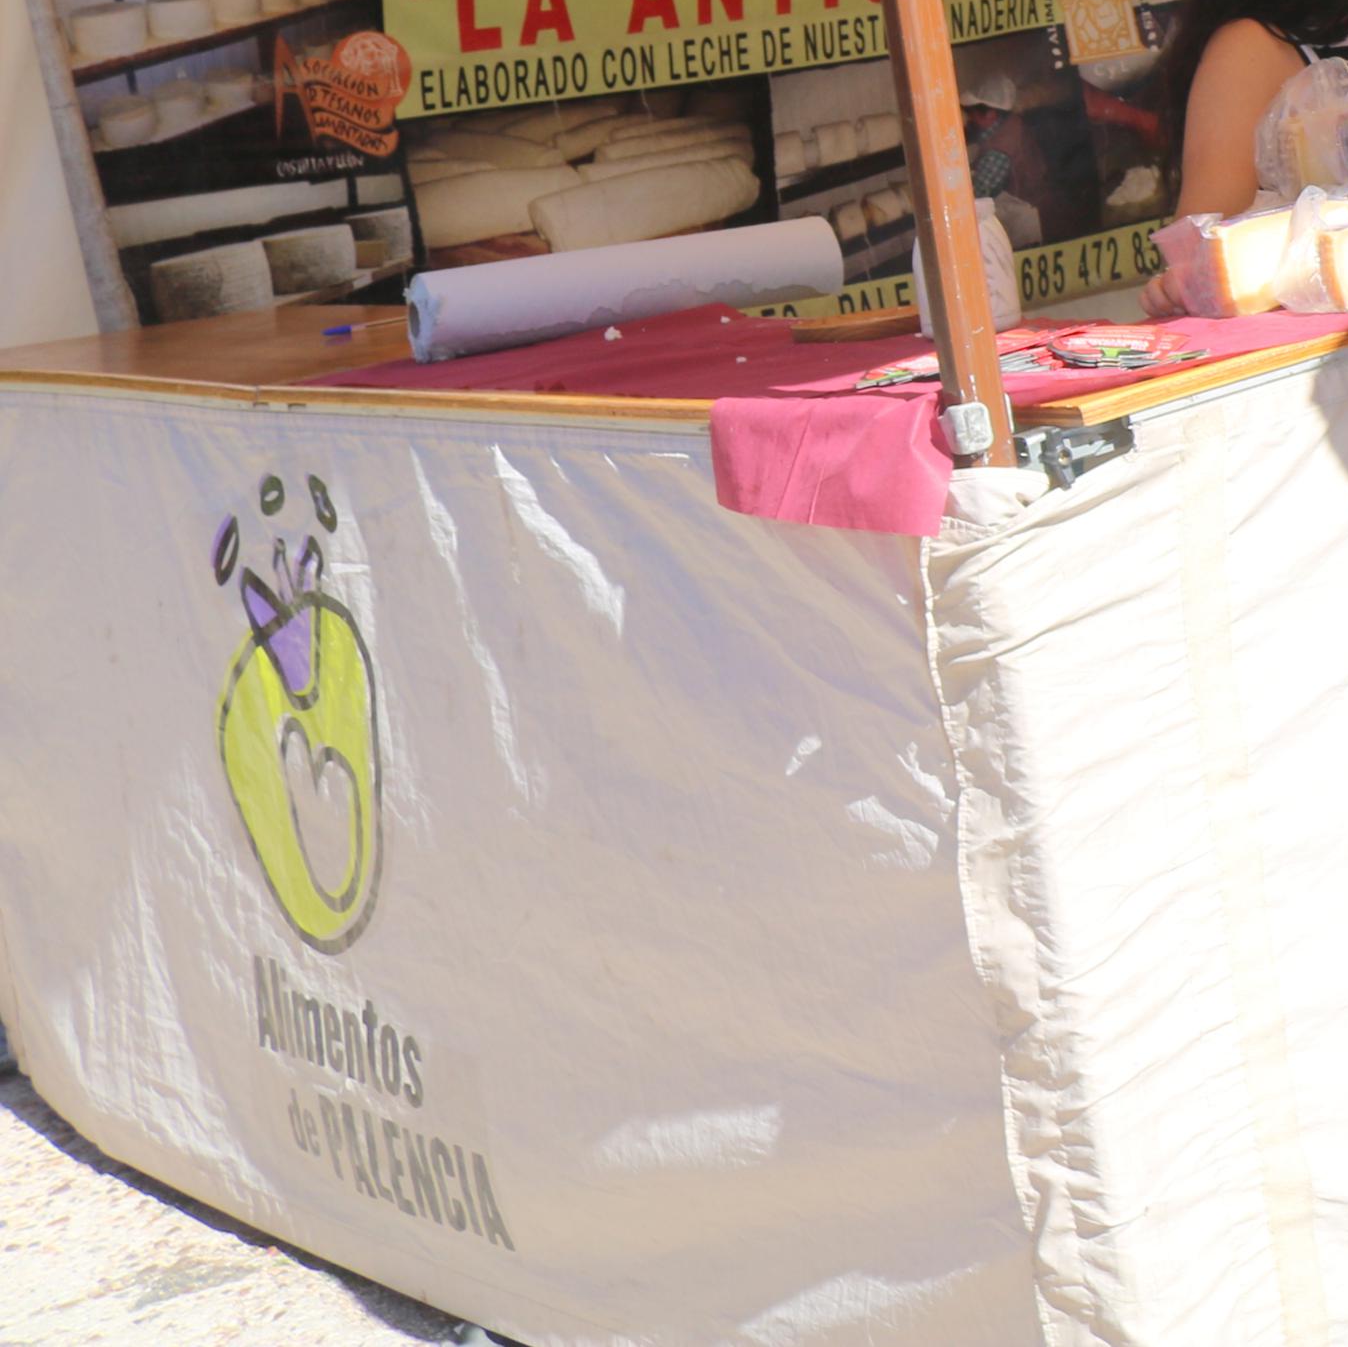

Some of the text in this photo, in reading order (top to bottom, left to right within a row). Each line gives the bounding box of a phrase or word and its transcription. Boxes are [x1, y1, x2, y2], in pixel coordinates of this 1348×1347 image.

[421, 53, 589, 111] ELABORADO
[601, 44, 656, 90] CON
[669, 32, 757, 80] LECHE
[762, 26, 796, 68] DE
[803, 14, 890, 63] NUEST
[1021, 249, 1065, 301] 685
[1078, 237, 1123, 287] 472
[252, 954, 424, 1109] Alimentos
[286, 1087, 517, 1254] de PALENCIA
